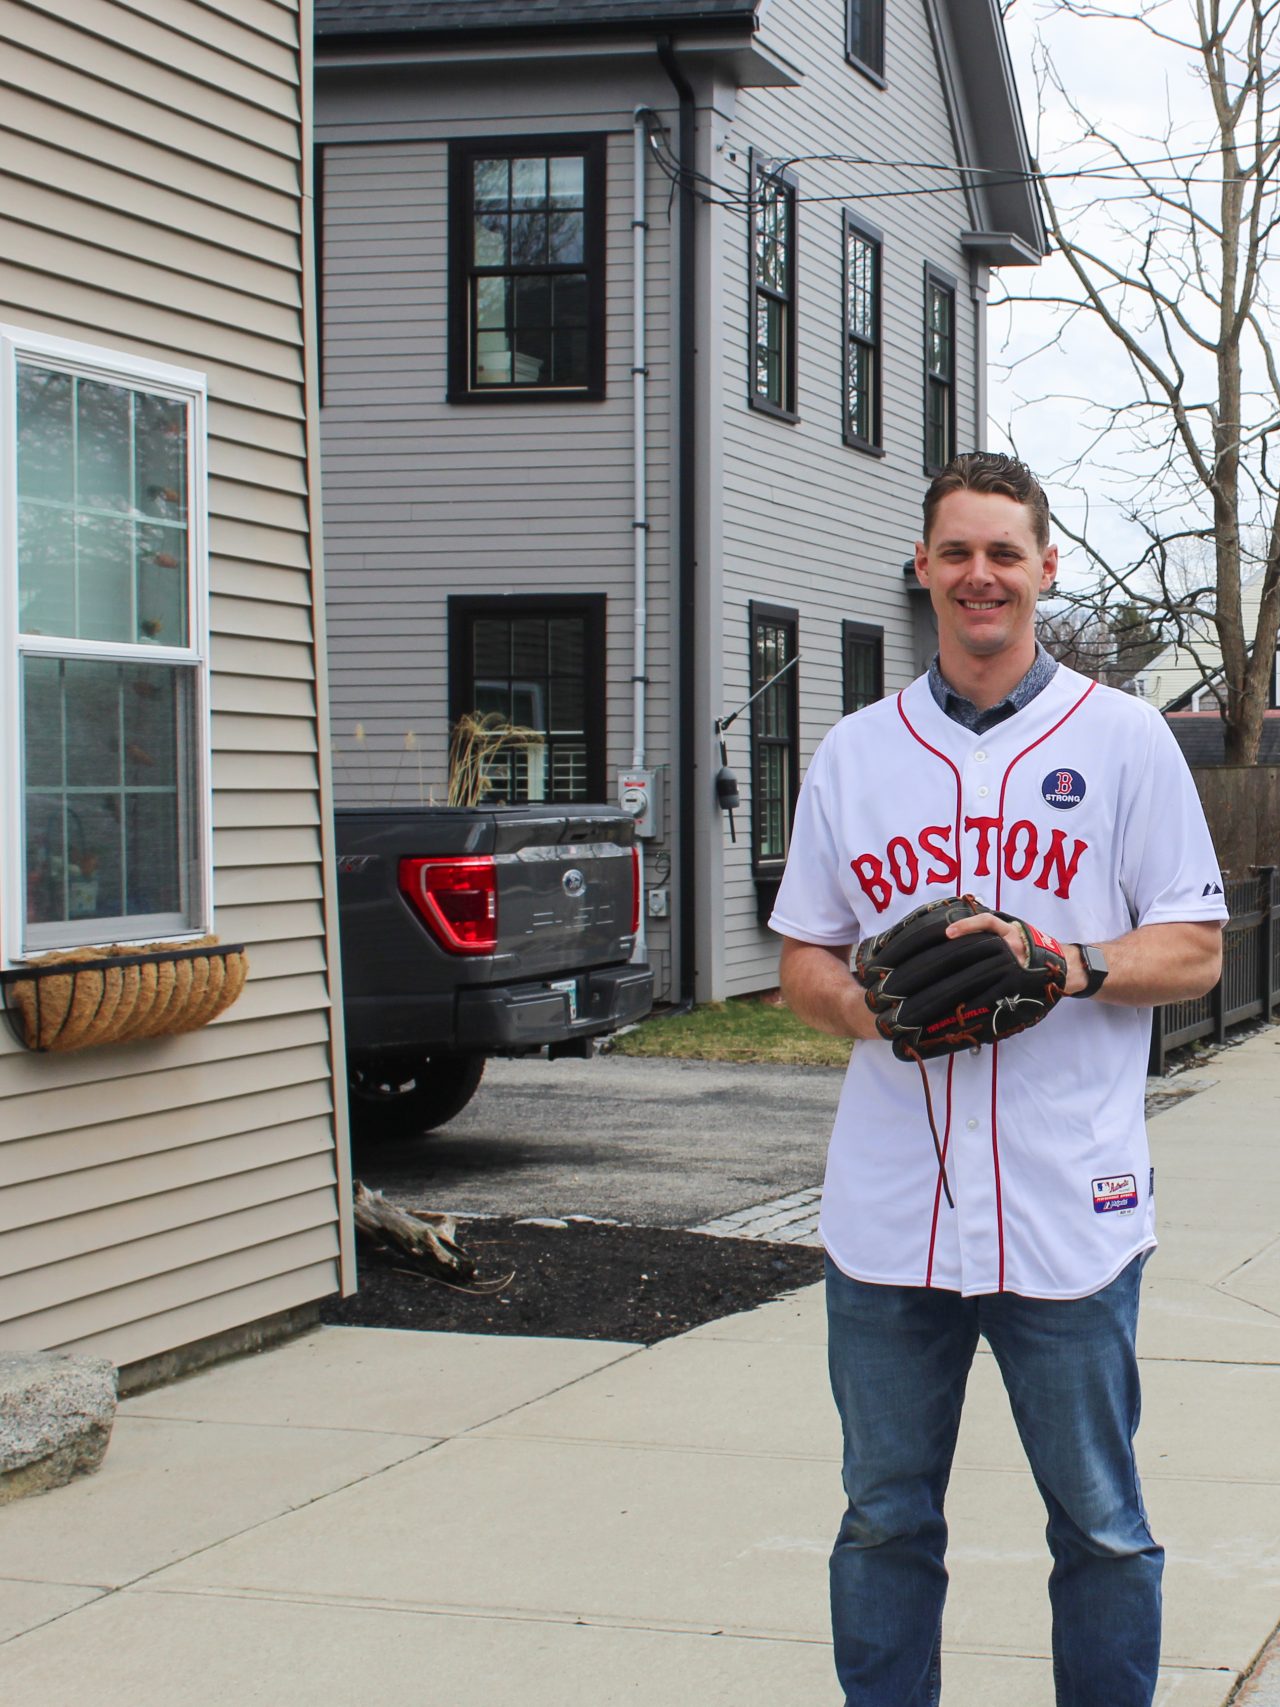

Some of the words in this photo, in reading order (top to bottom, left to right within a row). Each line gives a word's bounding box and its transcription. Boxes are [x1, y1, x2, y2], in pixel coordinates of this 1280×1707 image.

[1055, 771, 1073, 794] B
[1045, 793, 1081, 803] STRONG
[850, 816, 1088, 913] BOSTON
